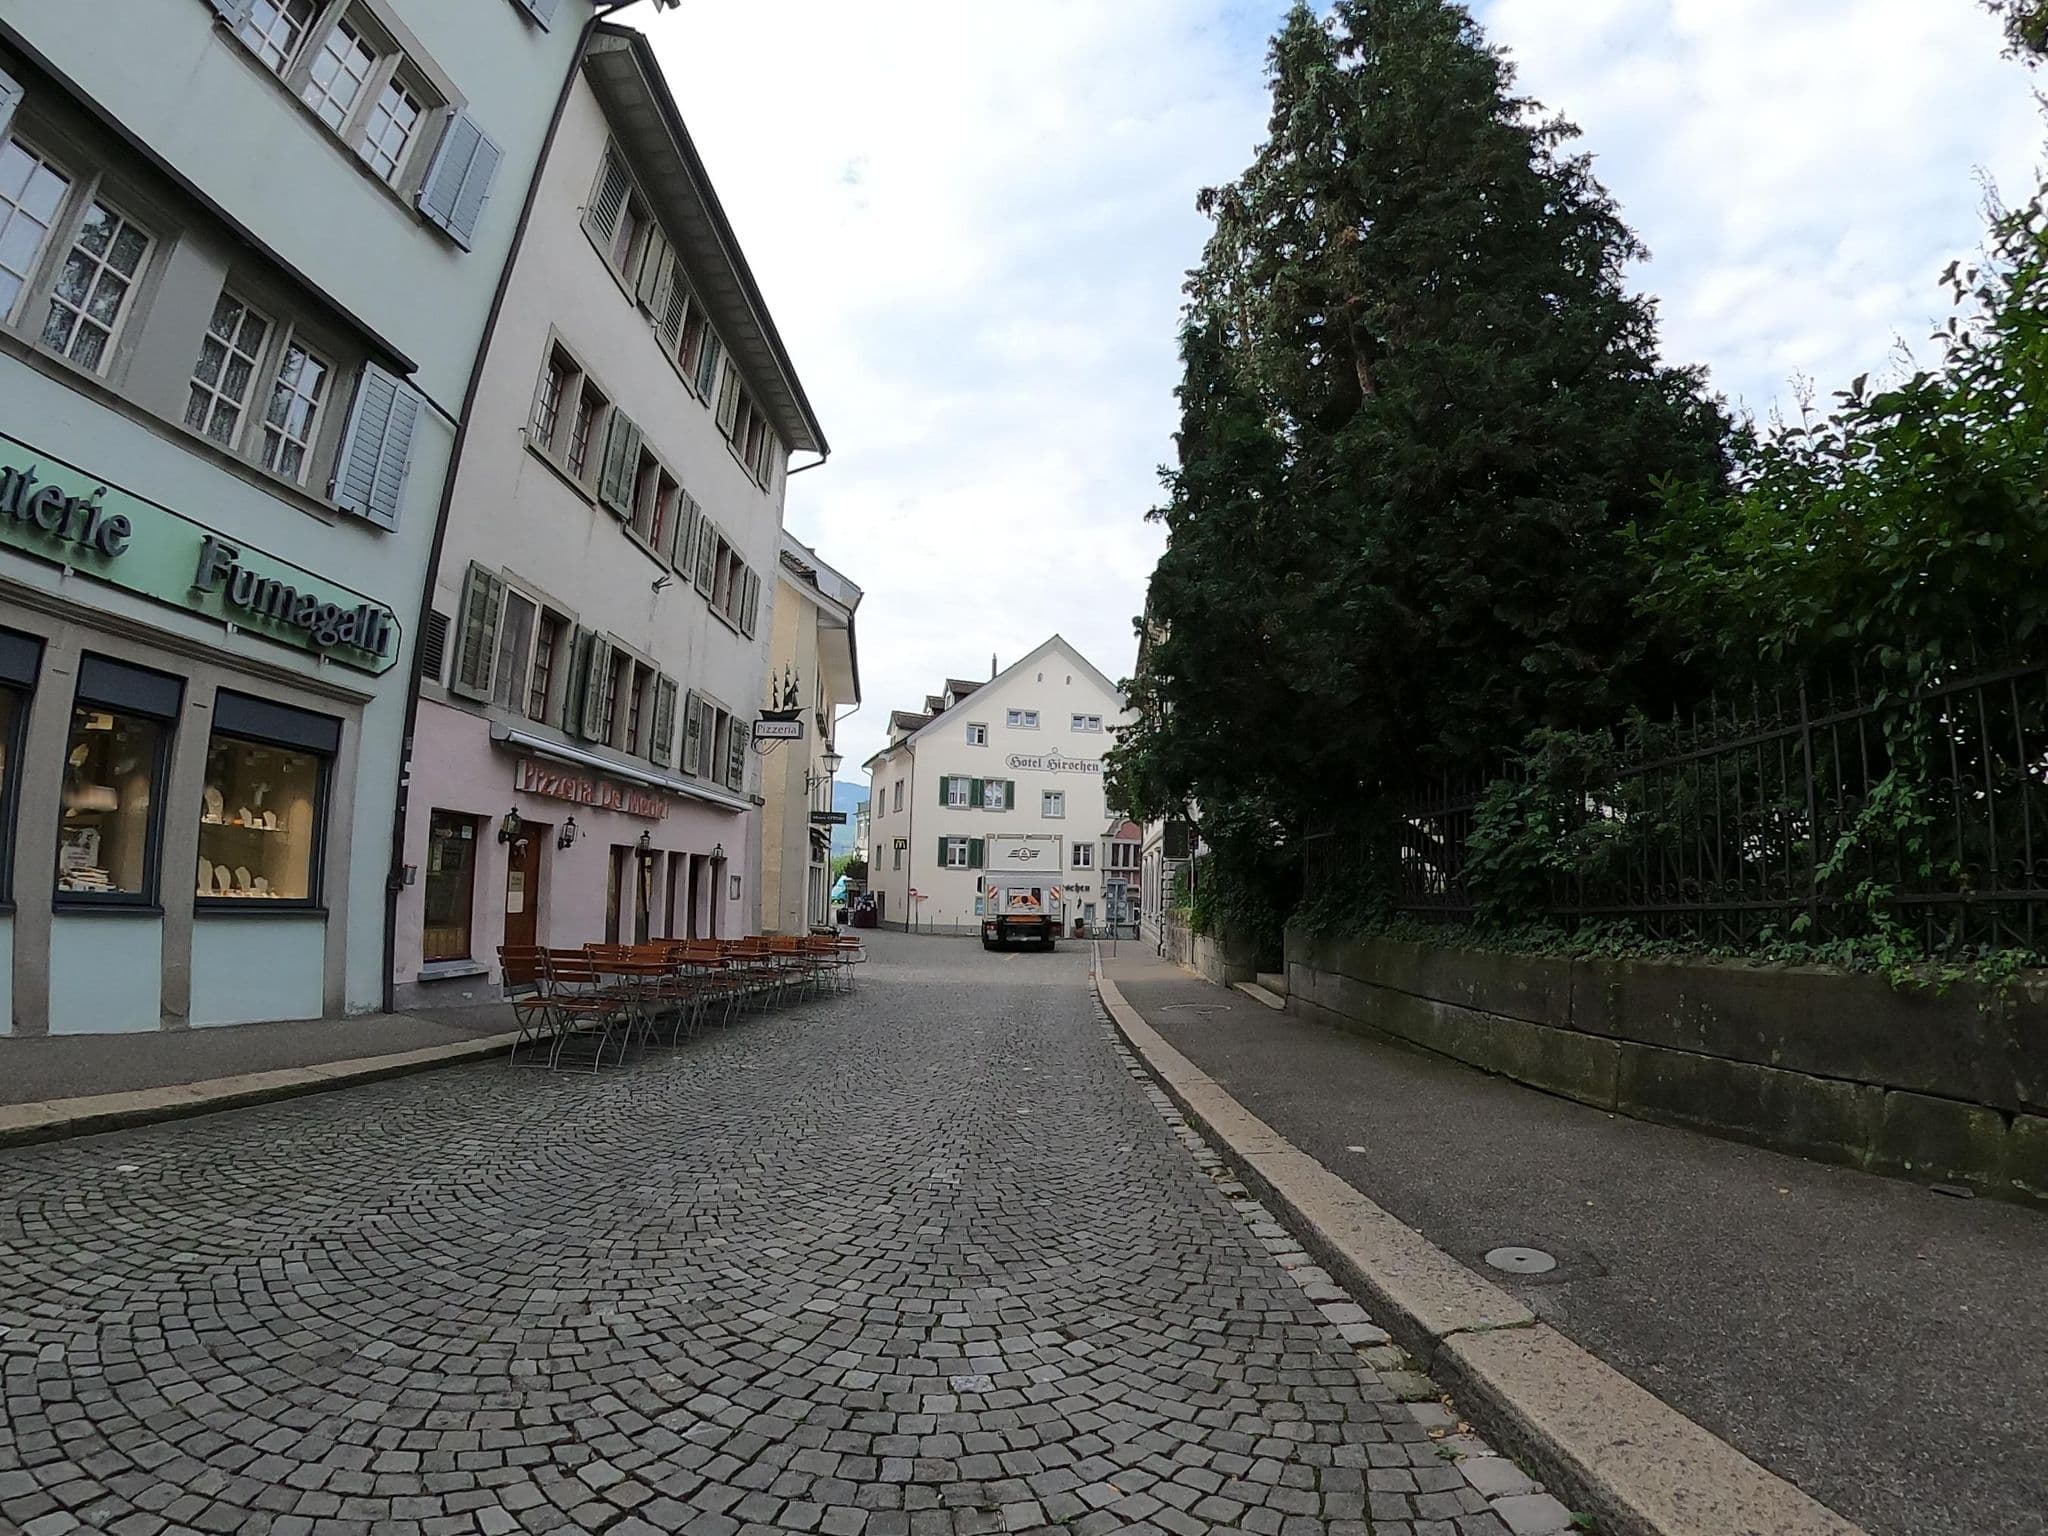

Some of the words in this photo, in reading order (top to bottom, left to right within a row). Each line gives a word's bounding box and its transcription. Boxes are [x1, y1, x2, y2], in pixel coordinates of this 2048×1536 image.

[191, 534, 393, 658] Fumagalli
[757, 724, 797, 735] Pizzeria
[1010, 756, 1041, 769] Hotel
[525, 758, 594, 804] Pizzeria
